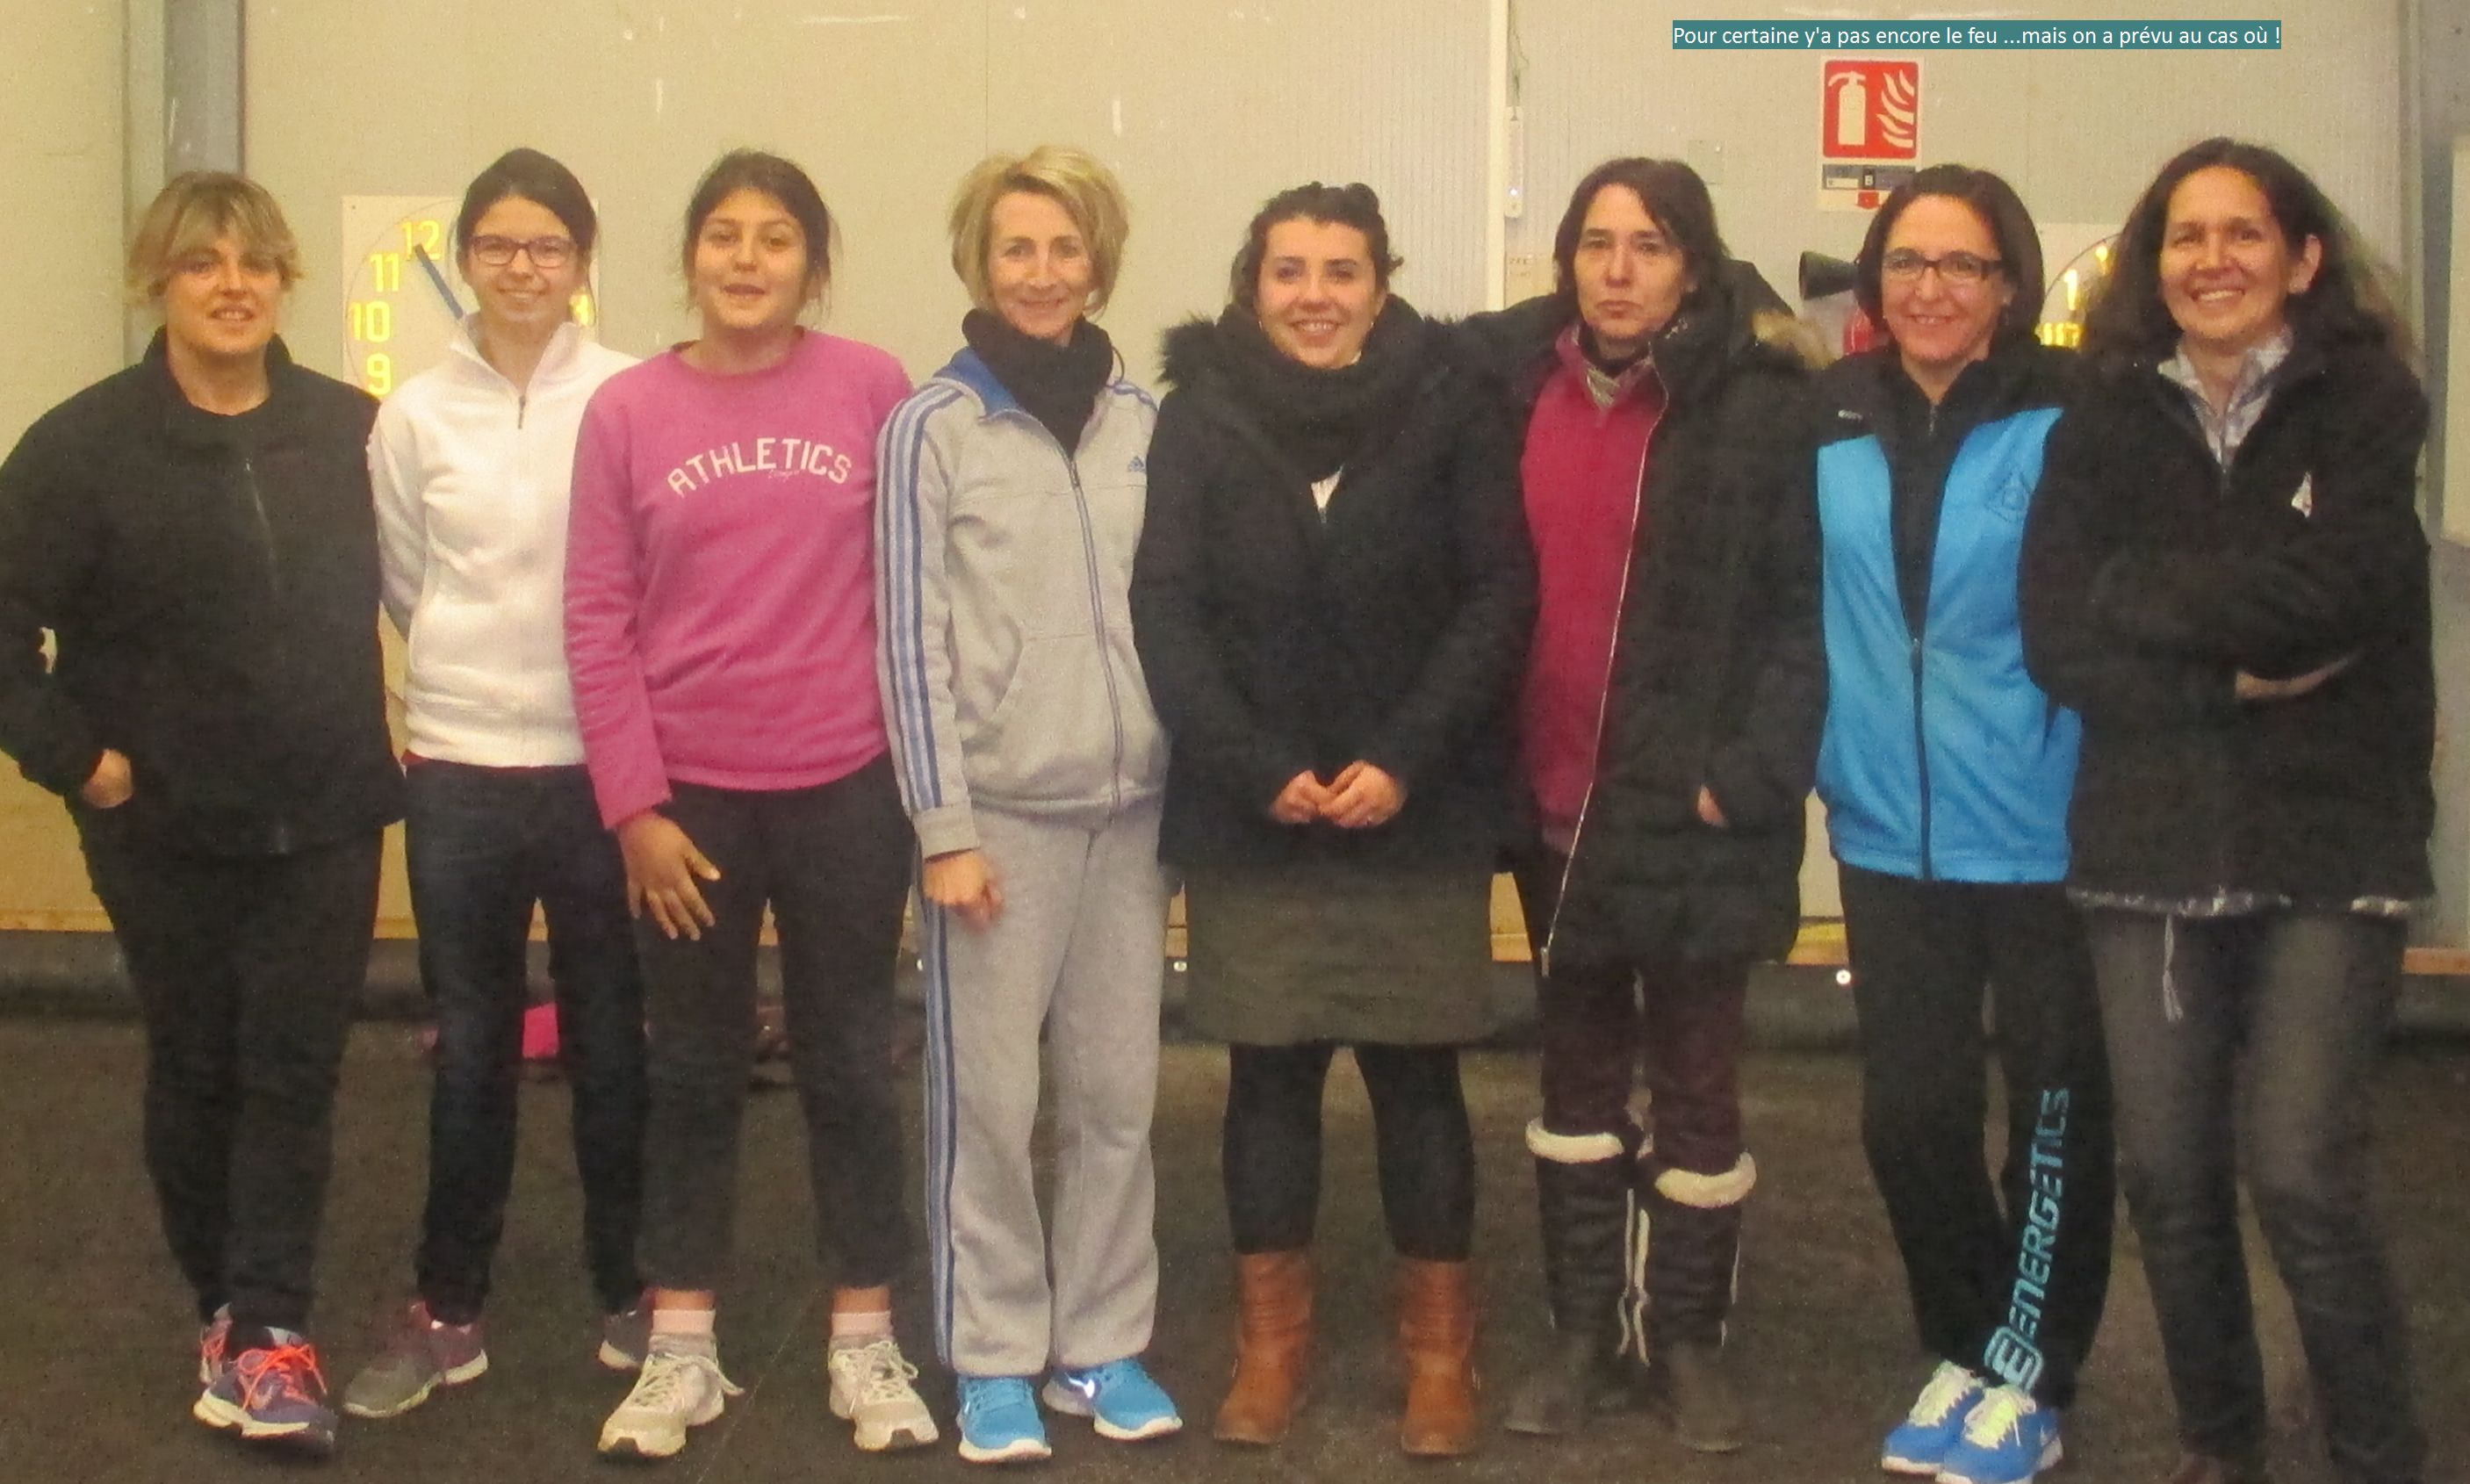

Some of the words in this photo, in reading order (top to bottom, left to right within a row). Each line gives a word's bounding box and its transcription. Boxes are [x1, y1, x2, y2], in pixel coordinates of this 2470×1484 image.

[401, 220, 441, 261] 12
[370, 252, 400, 292] 11
[351, 300, 391, 342] 10
[366, 352, 392, 396] 9
[667, 437, 852, 497] ATHLETICS
